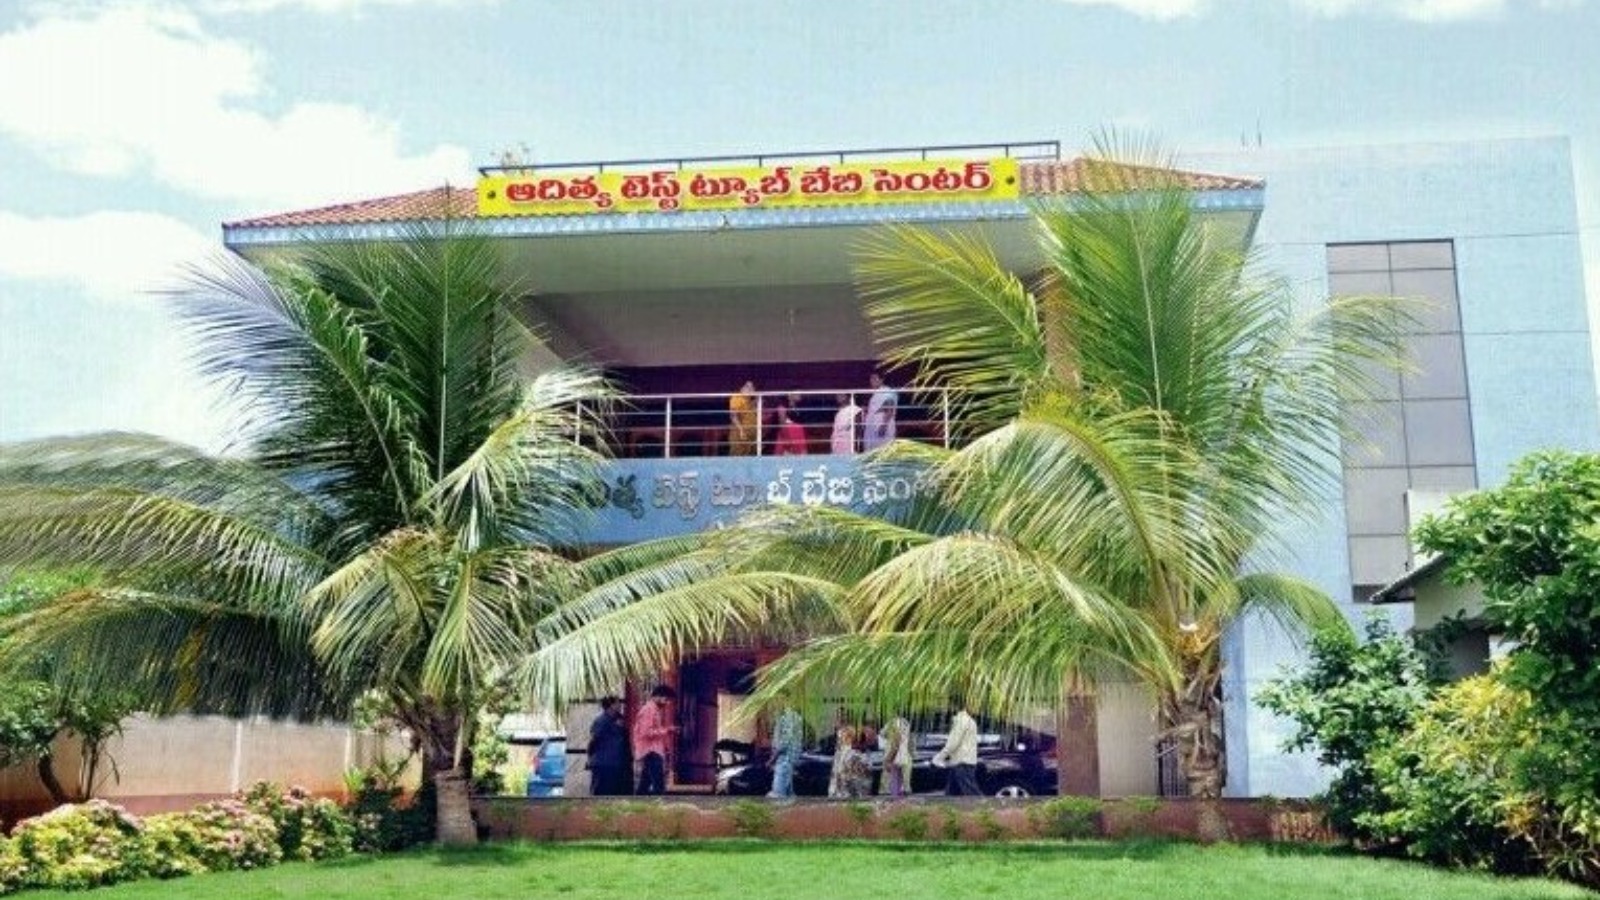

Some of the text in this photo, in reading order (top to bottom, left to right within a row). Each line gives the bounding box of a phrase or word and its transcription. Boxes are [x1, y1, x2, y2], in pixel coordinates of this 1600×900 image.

[506, 162, 991, 210] ఆదిత్య టెస్ట్ ట్యూబ్ బేబి సెంటర్
[802, 465, 854, 507] బేబి
